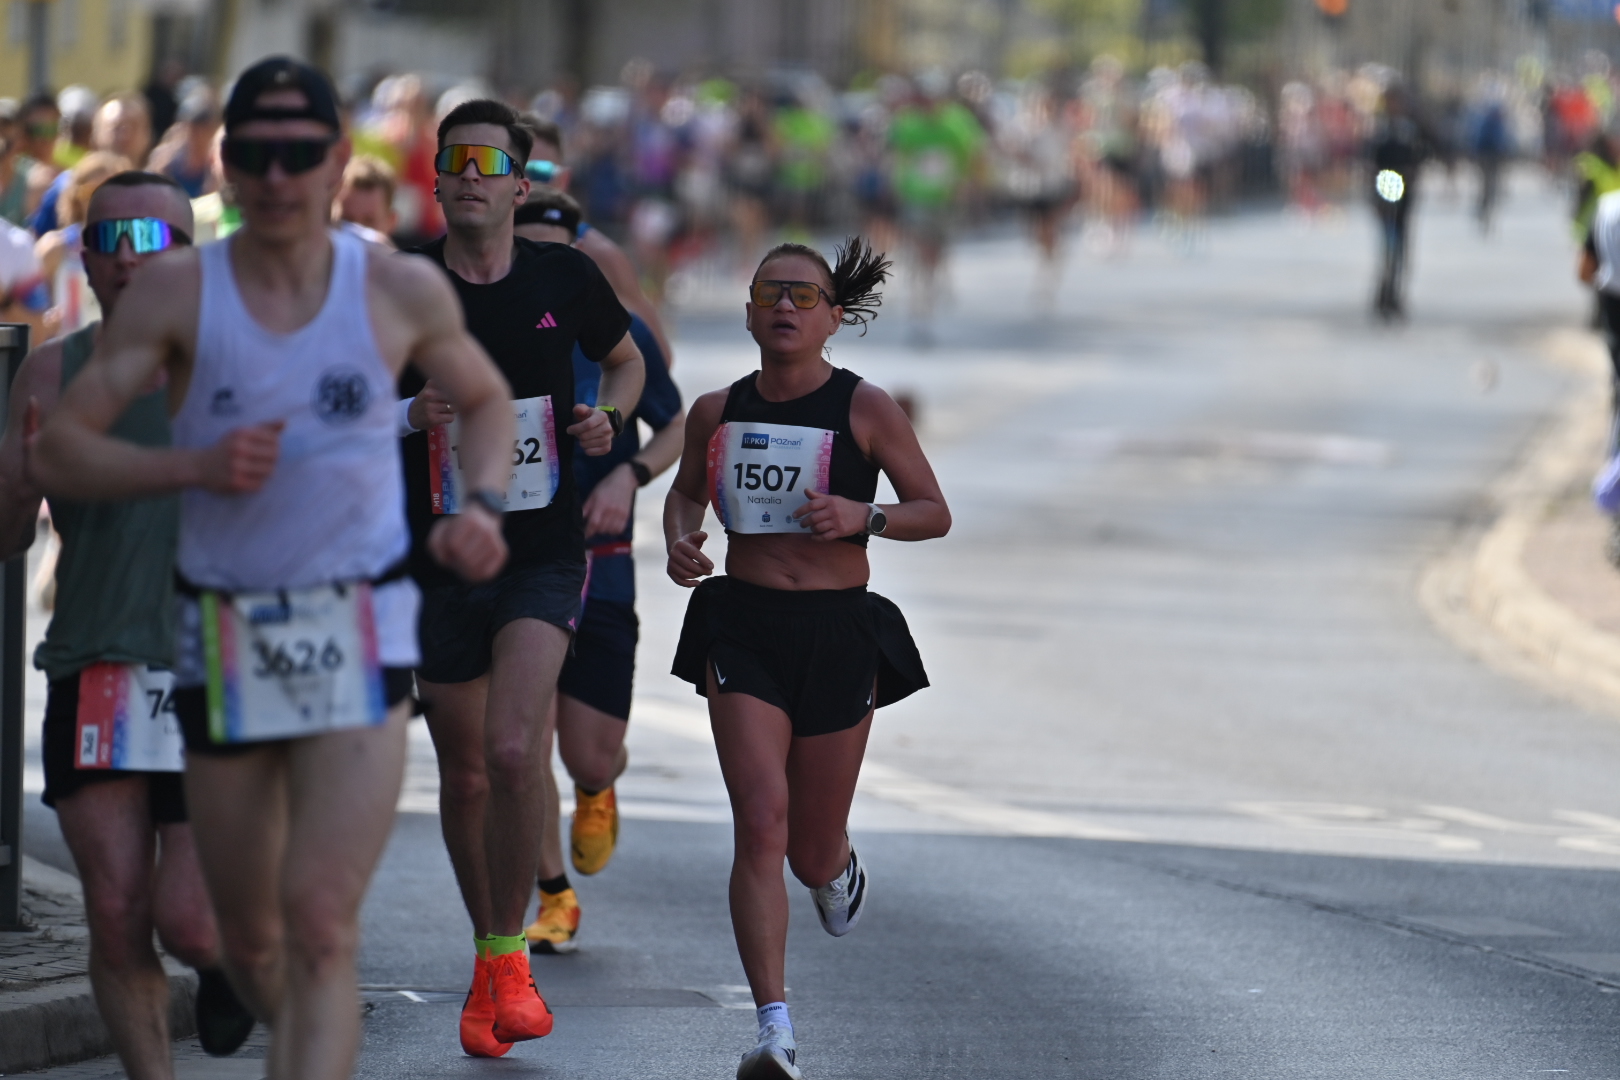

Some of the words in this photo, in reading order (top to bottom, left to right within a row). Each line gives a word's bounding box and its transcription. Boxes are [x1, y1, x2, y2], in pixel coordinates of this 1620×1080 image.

[734, 463, 802, 492] 1507
[432, 493, 440, 507] M18
[747, 496, 782, 505] Natalia
[253, 636, 344, 678] 3626
